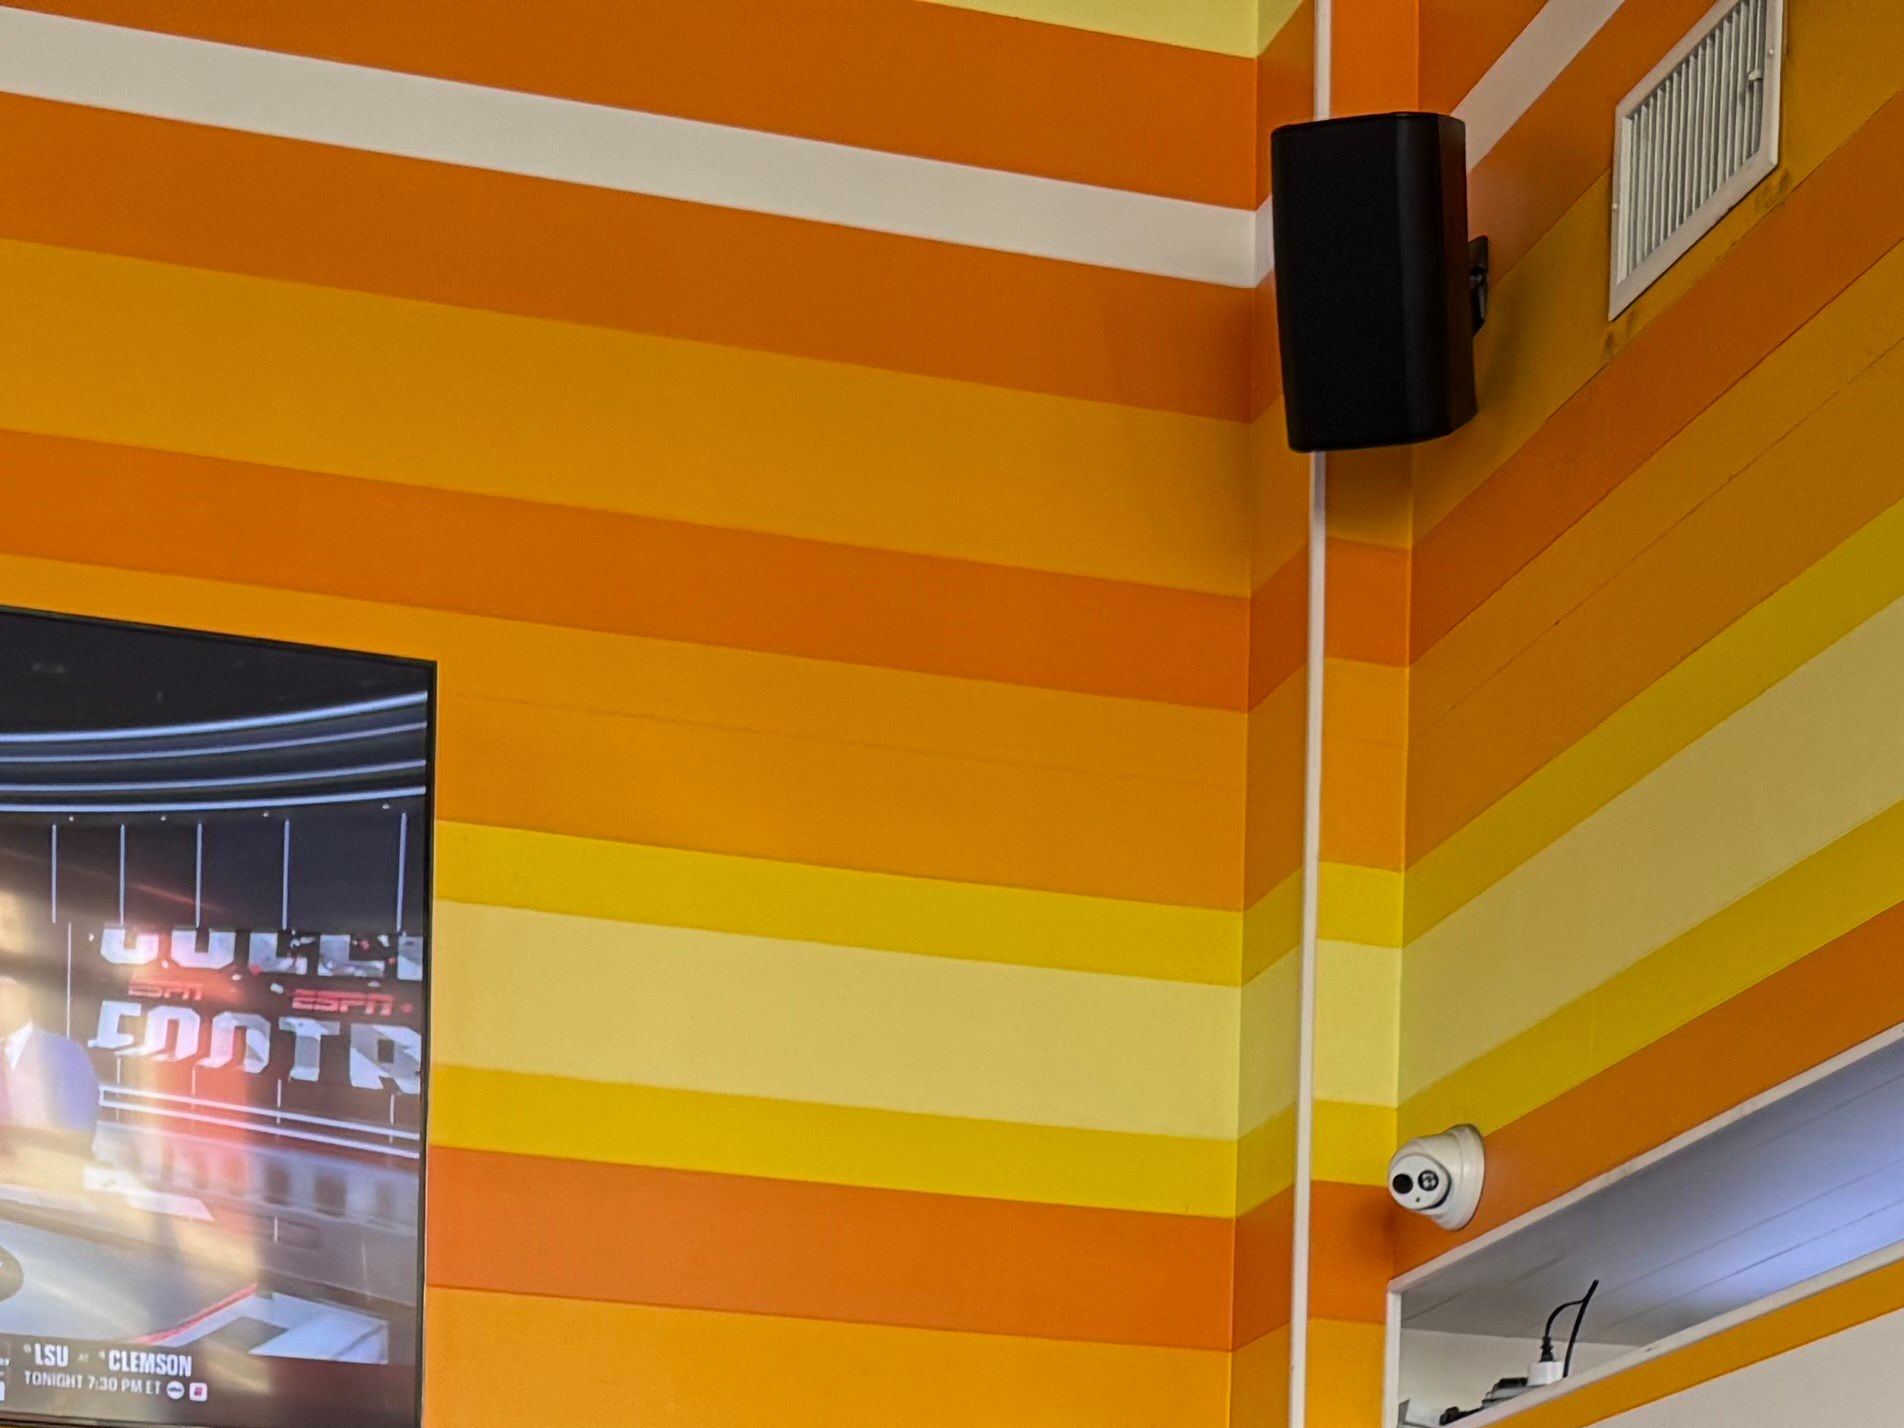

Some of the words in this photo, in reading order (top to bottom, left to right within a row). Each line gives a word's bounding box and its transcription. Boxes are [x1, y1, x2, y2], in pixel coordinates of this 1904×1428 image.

[34, 1342, 69, 1368] LSU
[108, 1349, 193, 1378] CLEMSON
[24, 1370, 83, 1389] TONIGHT
[88, 1375, 118, 1392] 7:30
[121, 1378, 143, 1394] PM
[145, 1380, 161, 1395] ET
